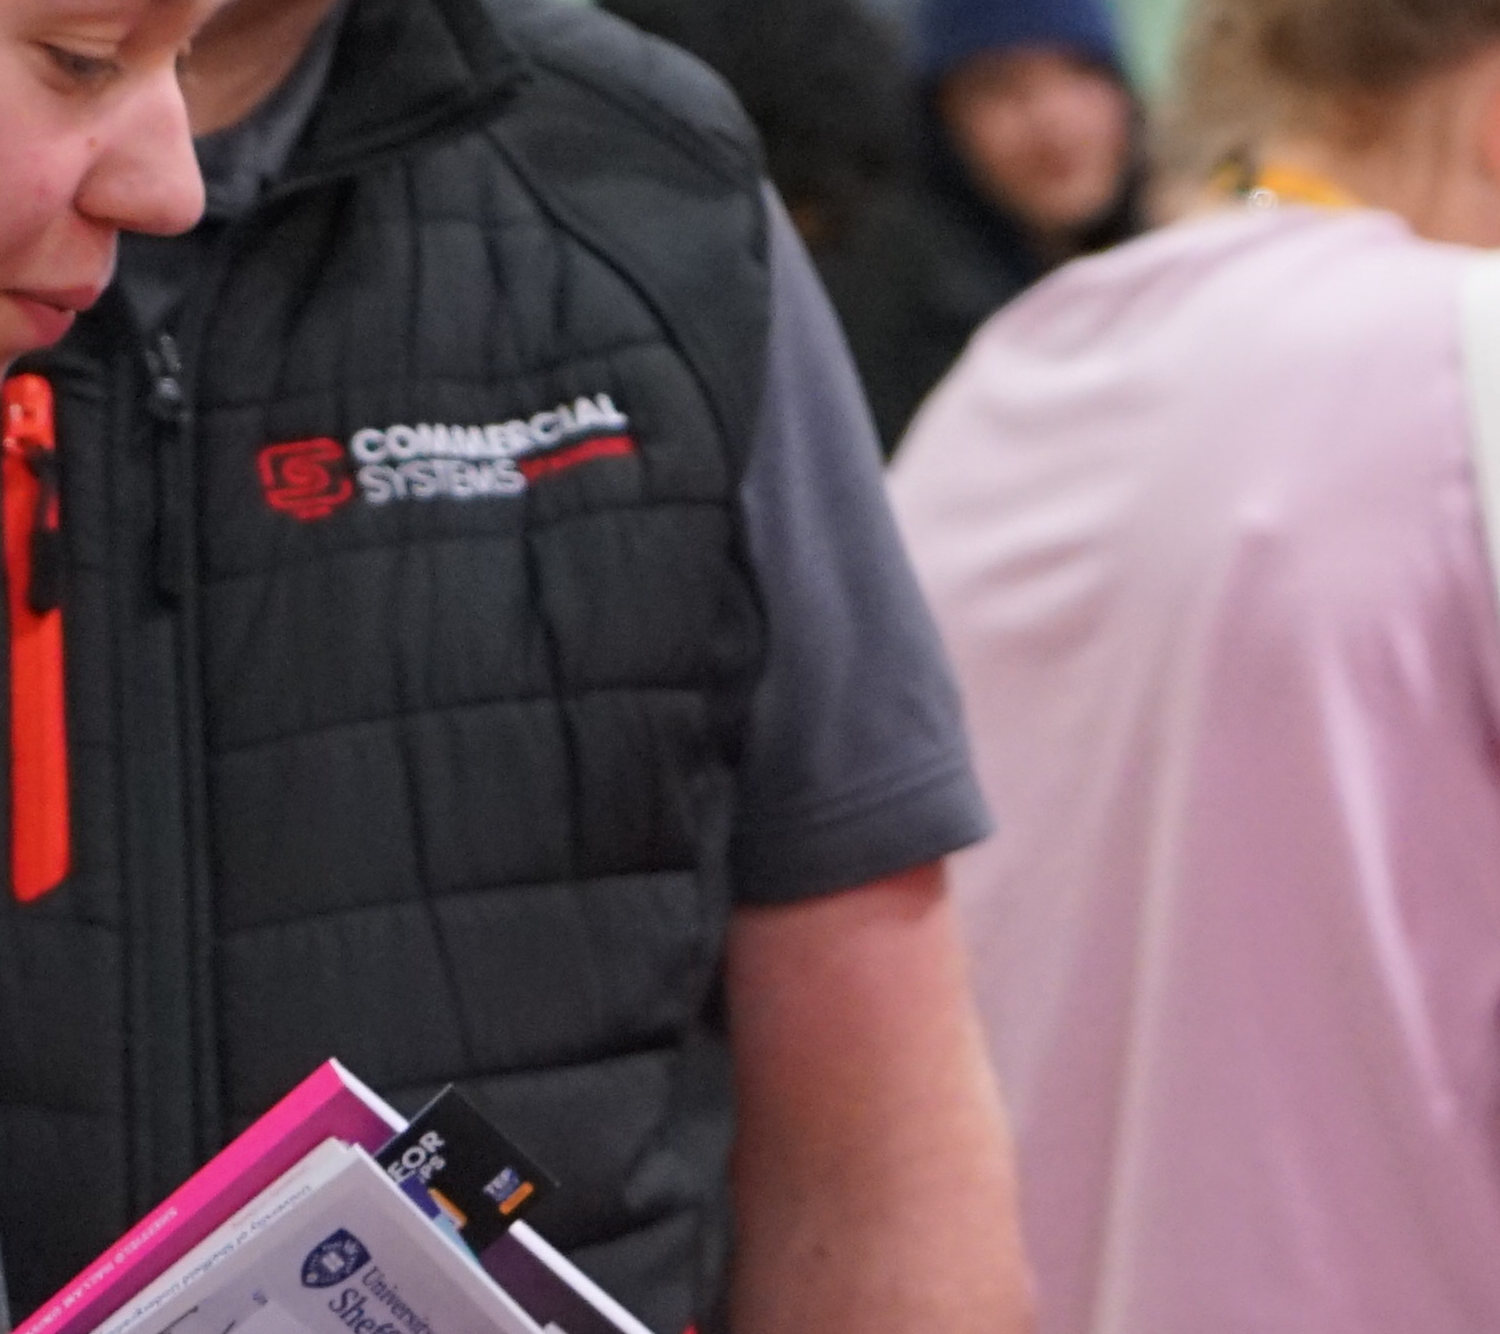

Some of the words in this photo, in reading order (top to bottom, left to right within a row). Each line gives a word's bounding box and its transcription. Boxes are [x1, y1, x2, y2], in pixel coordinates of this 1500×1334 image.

[349, 391, 629, 465] COMMERCIAL
[357, 457, 528, 505] SYSTEMS
[248, 1182, 313, 1234] University
[112, 1205, 178, 1265] SHEFFIELD
[178, 1241, 237, 1288] Sheffield
